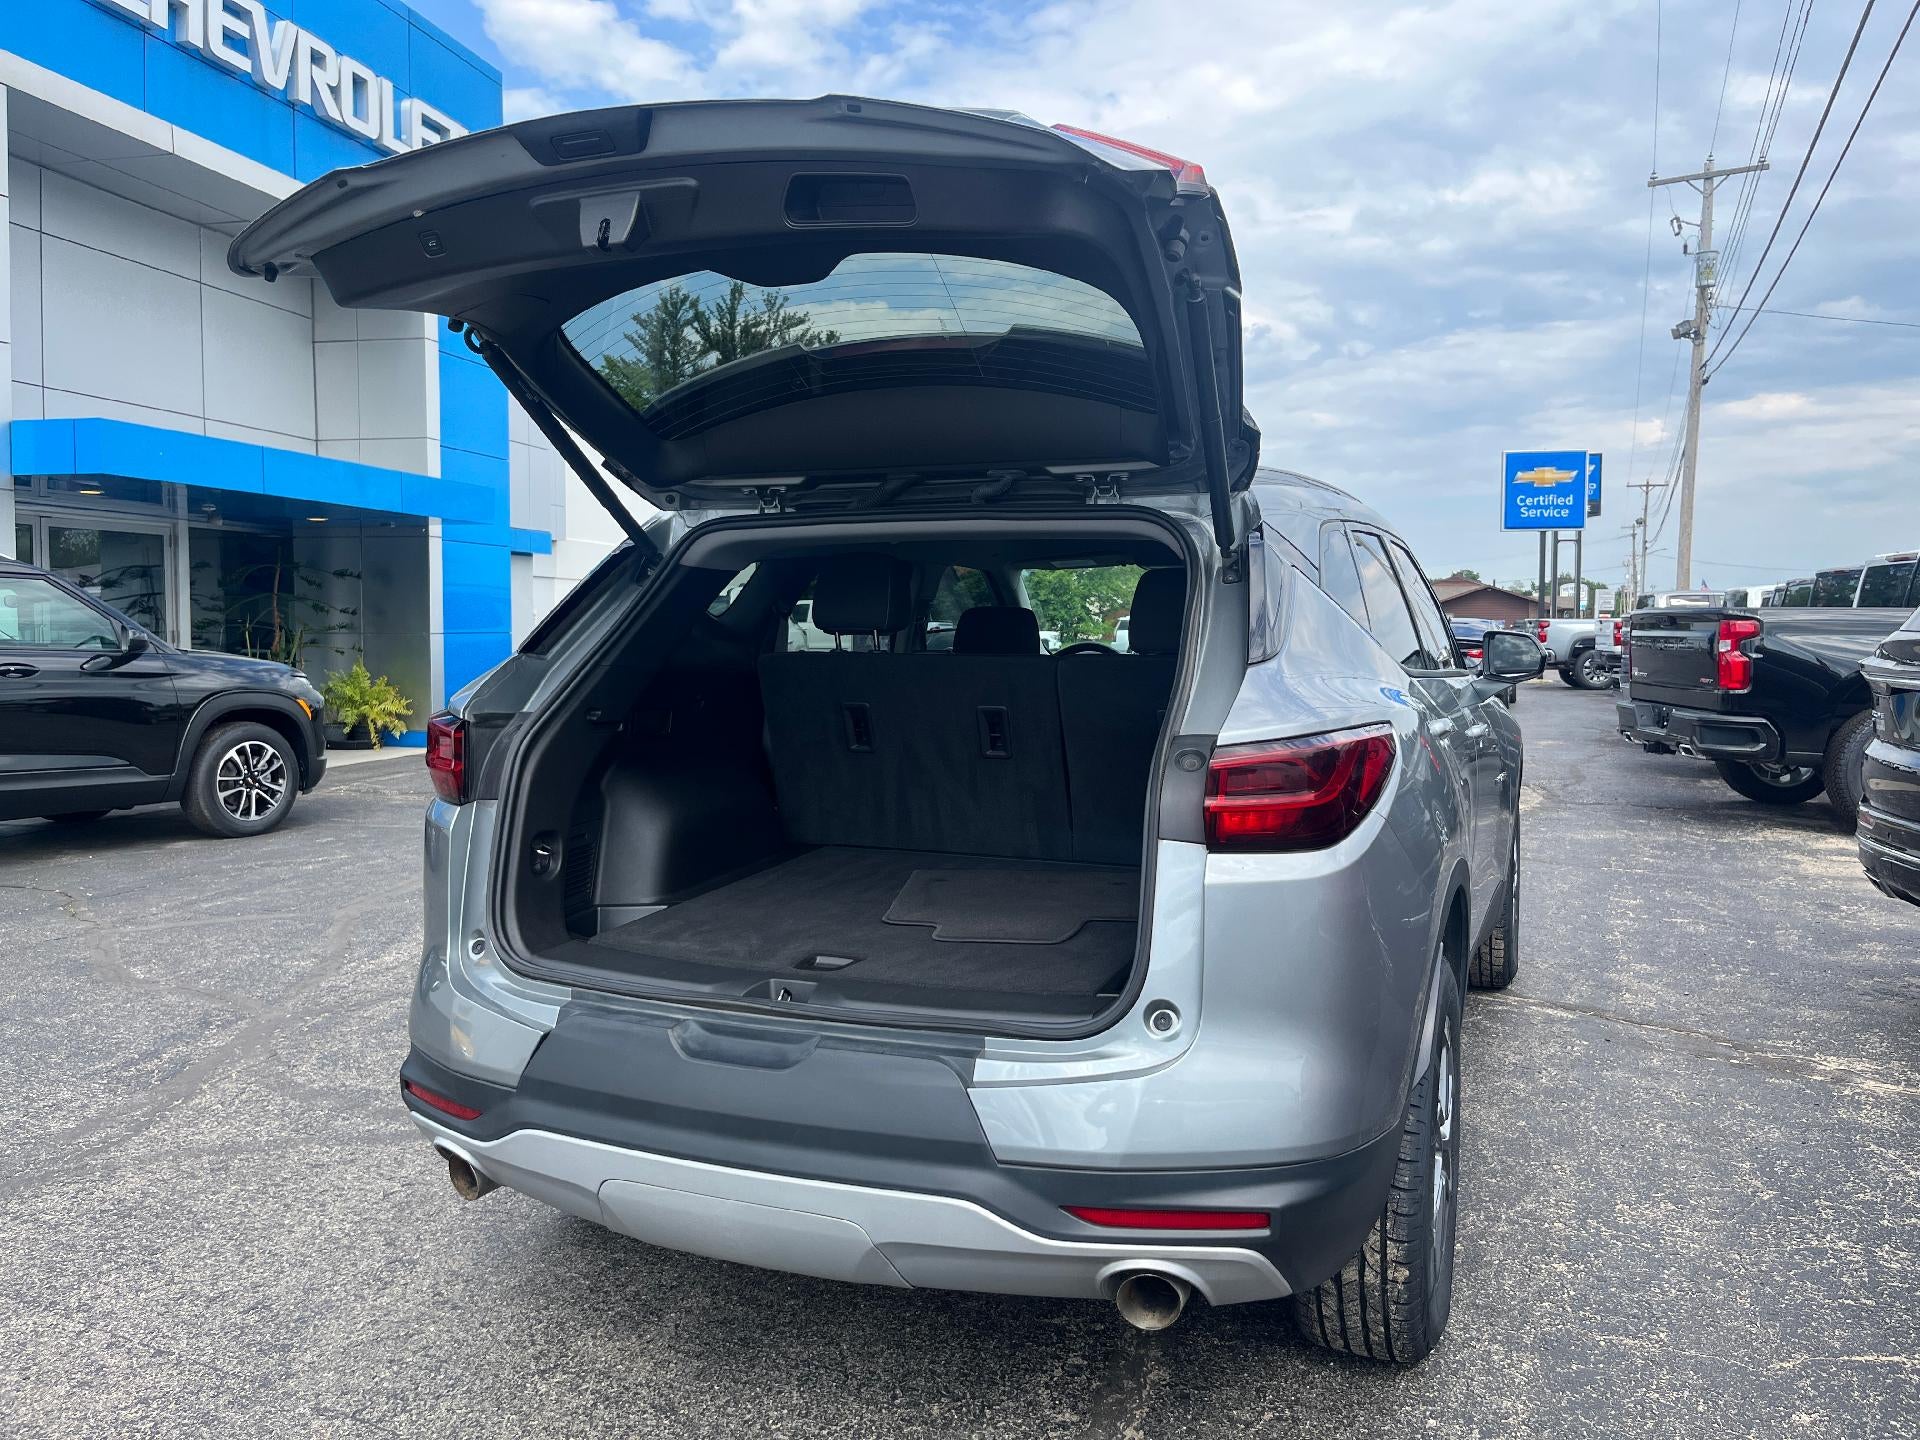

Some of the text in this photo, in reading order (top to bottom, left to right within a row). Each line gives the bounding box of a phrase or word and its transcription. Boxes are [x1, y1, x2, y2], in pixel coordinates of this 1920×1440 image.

[88, 0, 470, 154] HEVROLE
[1516, 494, 1574, 506] Certified
[1520, 506, 1569, 518] Service
